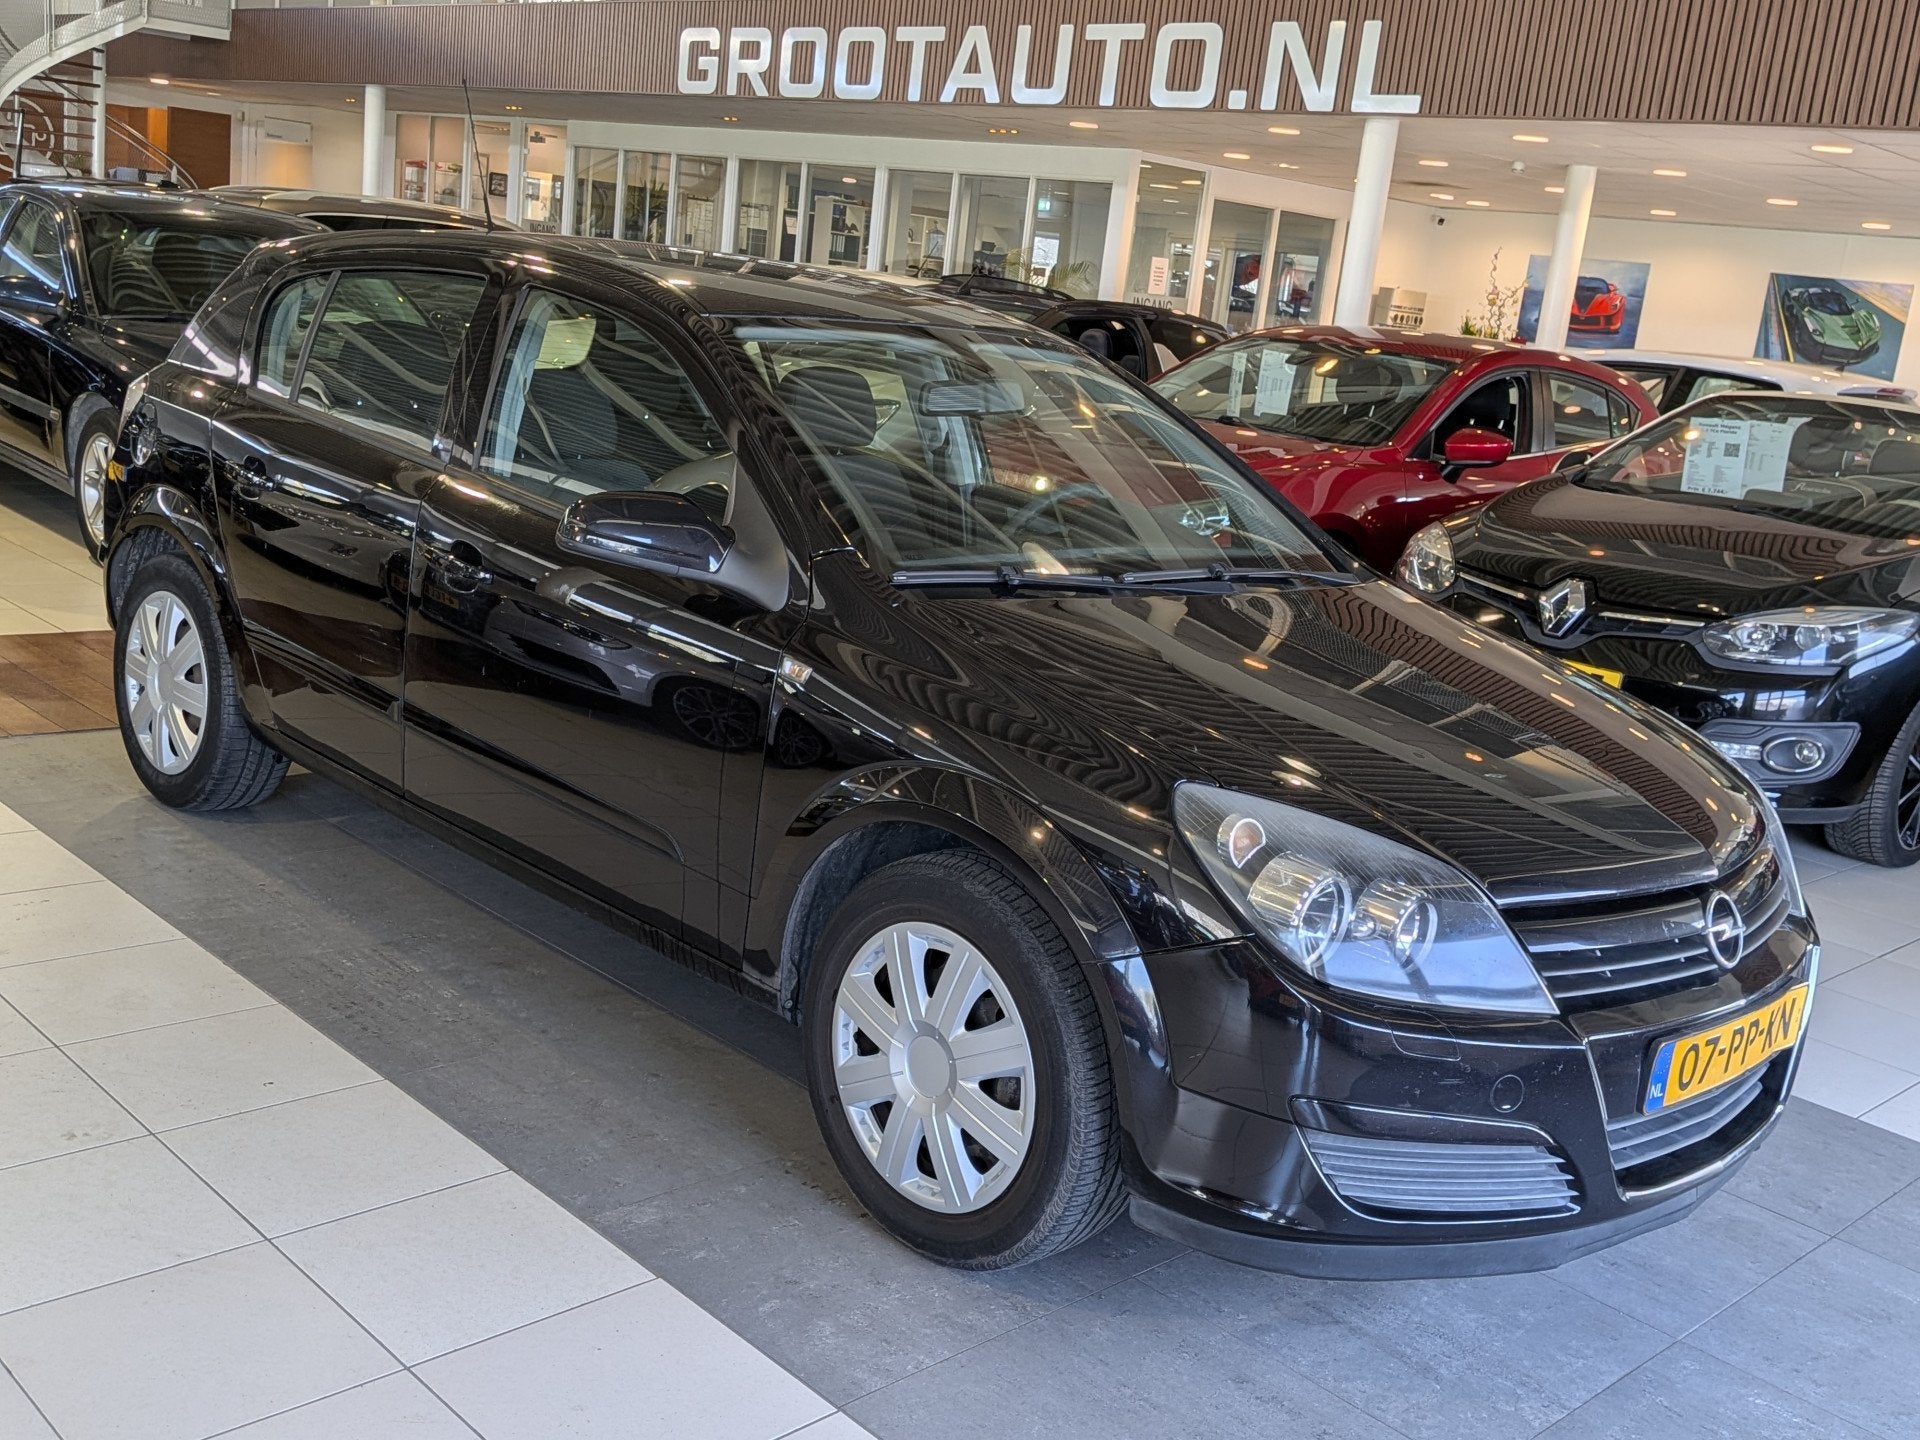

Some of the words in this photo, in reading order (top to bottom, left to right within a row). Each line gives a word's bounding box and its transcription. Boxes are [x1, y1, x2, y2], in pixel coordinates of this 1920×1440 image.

[677, 20, 1421, 113] GROOTAUTO.NL
[1650, 1083, 1664, 1098] NL
[1678, 997, 1798, 1092] 07-PP-KN
